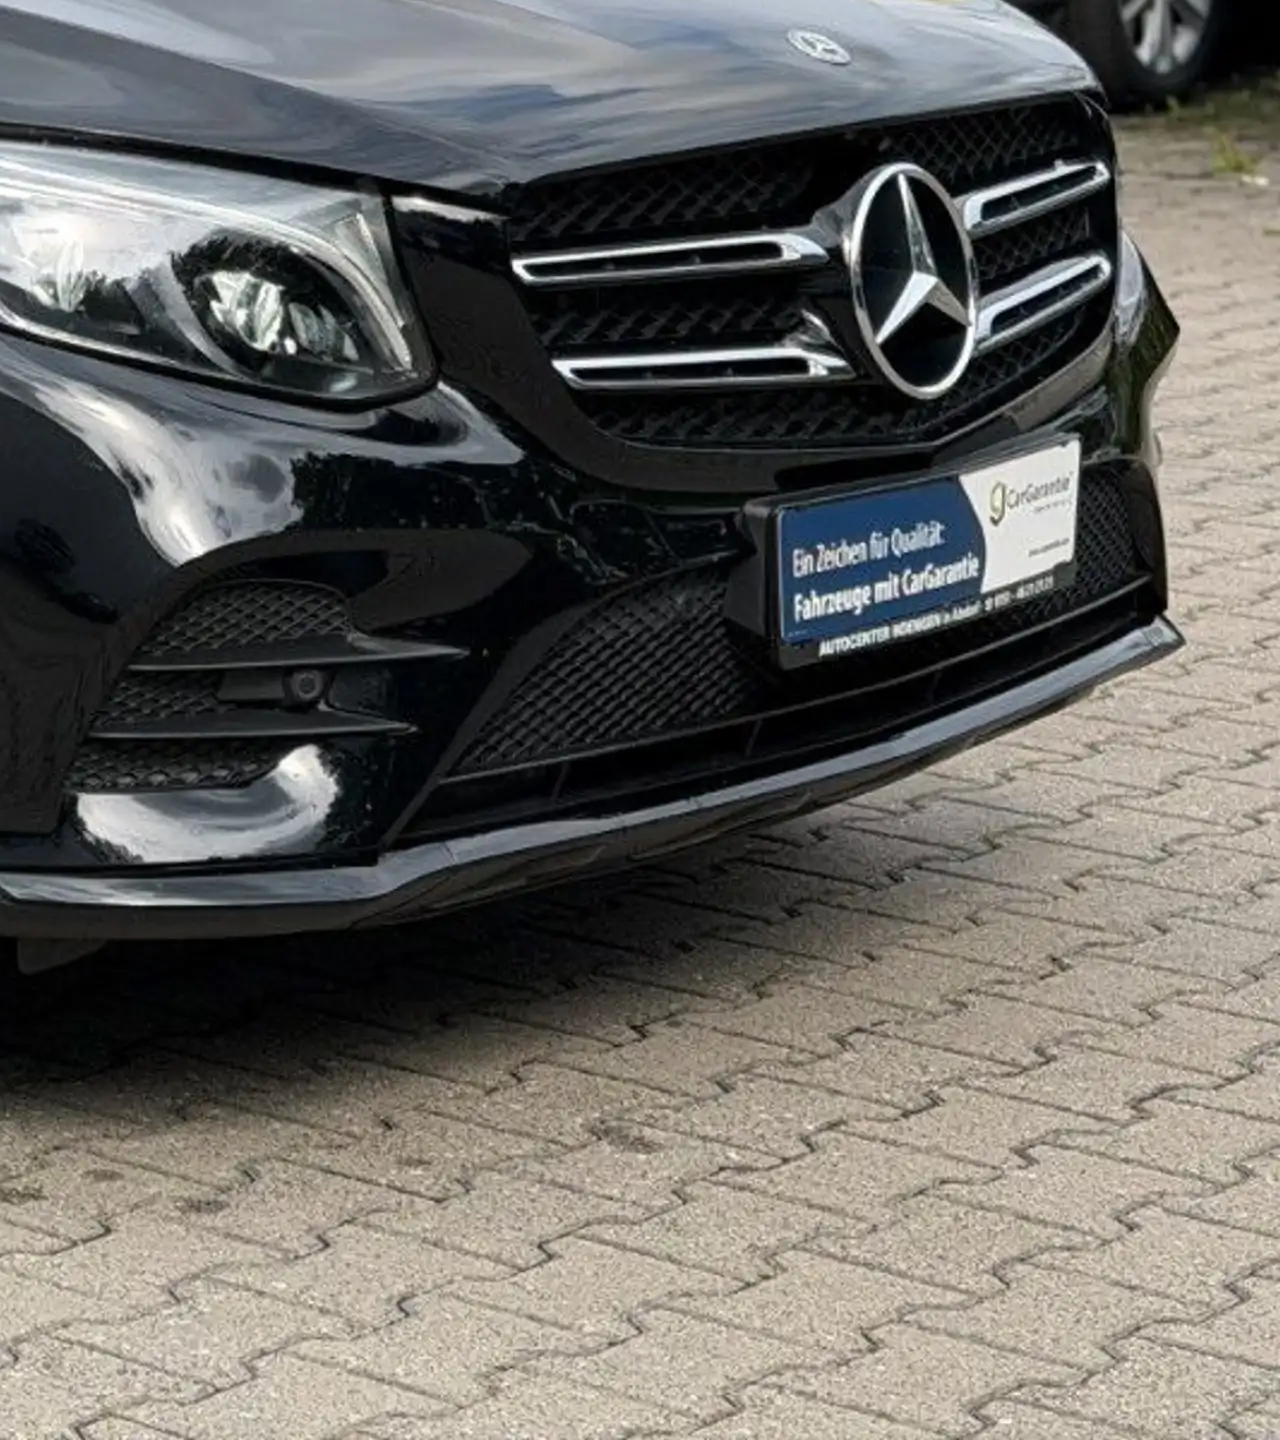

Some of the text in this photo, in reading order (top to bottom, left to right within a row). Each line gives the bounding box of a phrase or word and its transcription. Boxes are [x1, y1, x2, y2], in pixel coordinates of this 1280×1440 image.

[792, 548, 815, 578] Ein
[816, 540, 868, 572] Zeichen
[869, 530, 889, 560] für
[794, 589, 872, 623] Fahrzeuge
[874, 570, 900, 603] mit
[901, 550, 980, 596] CarGarantie
